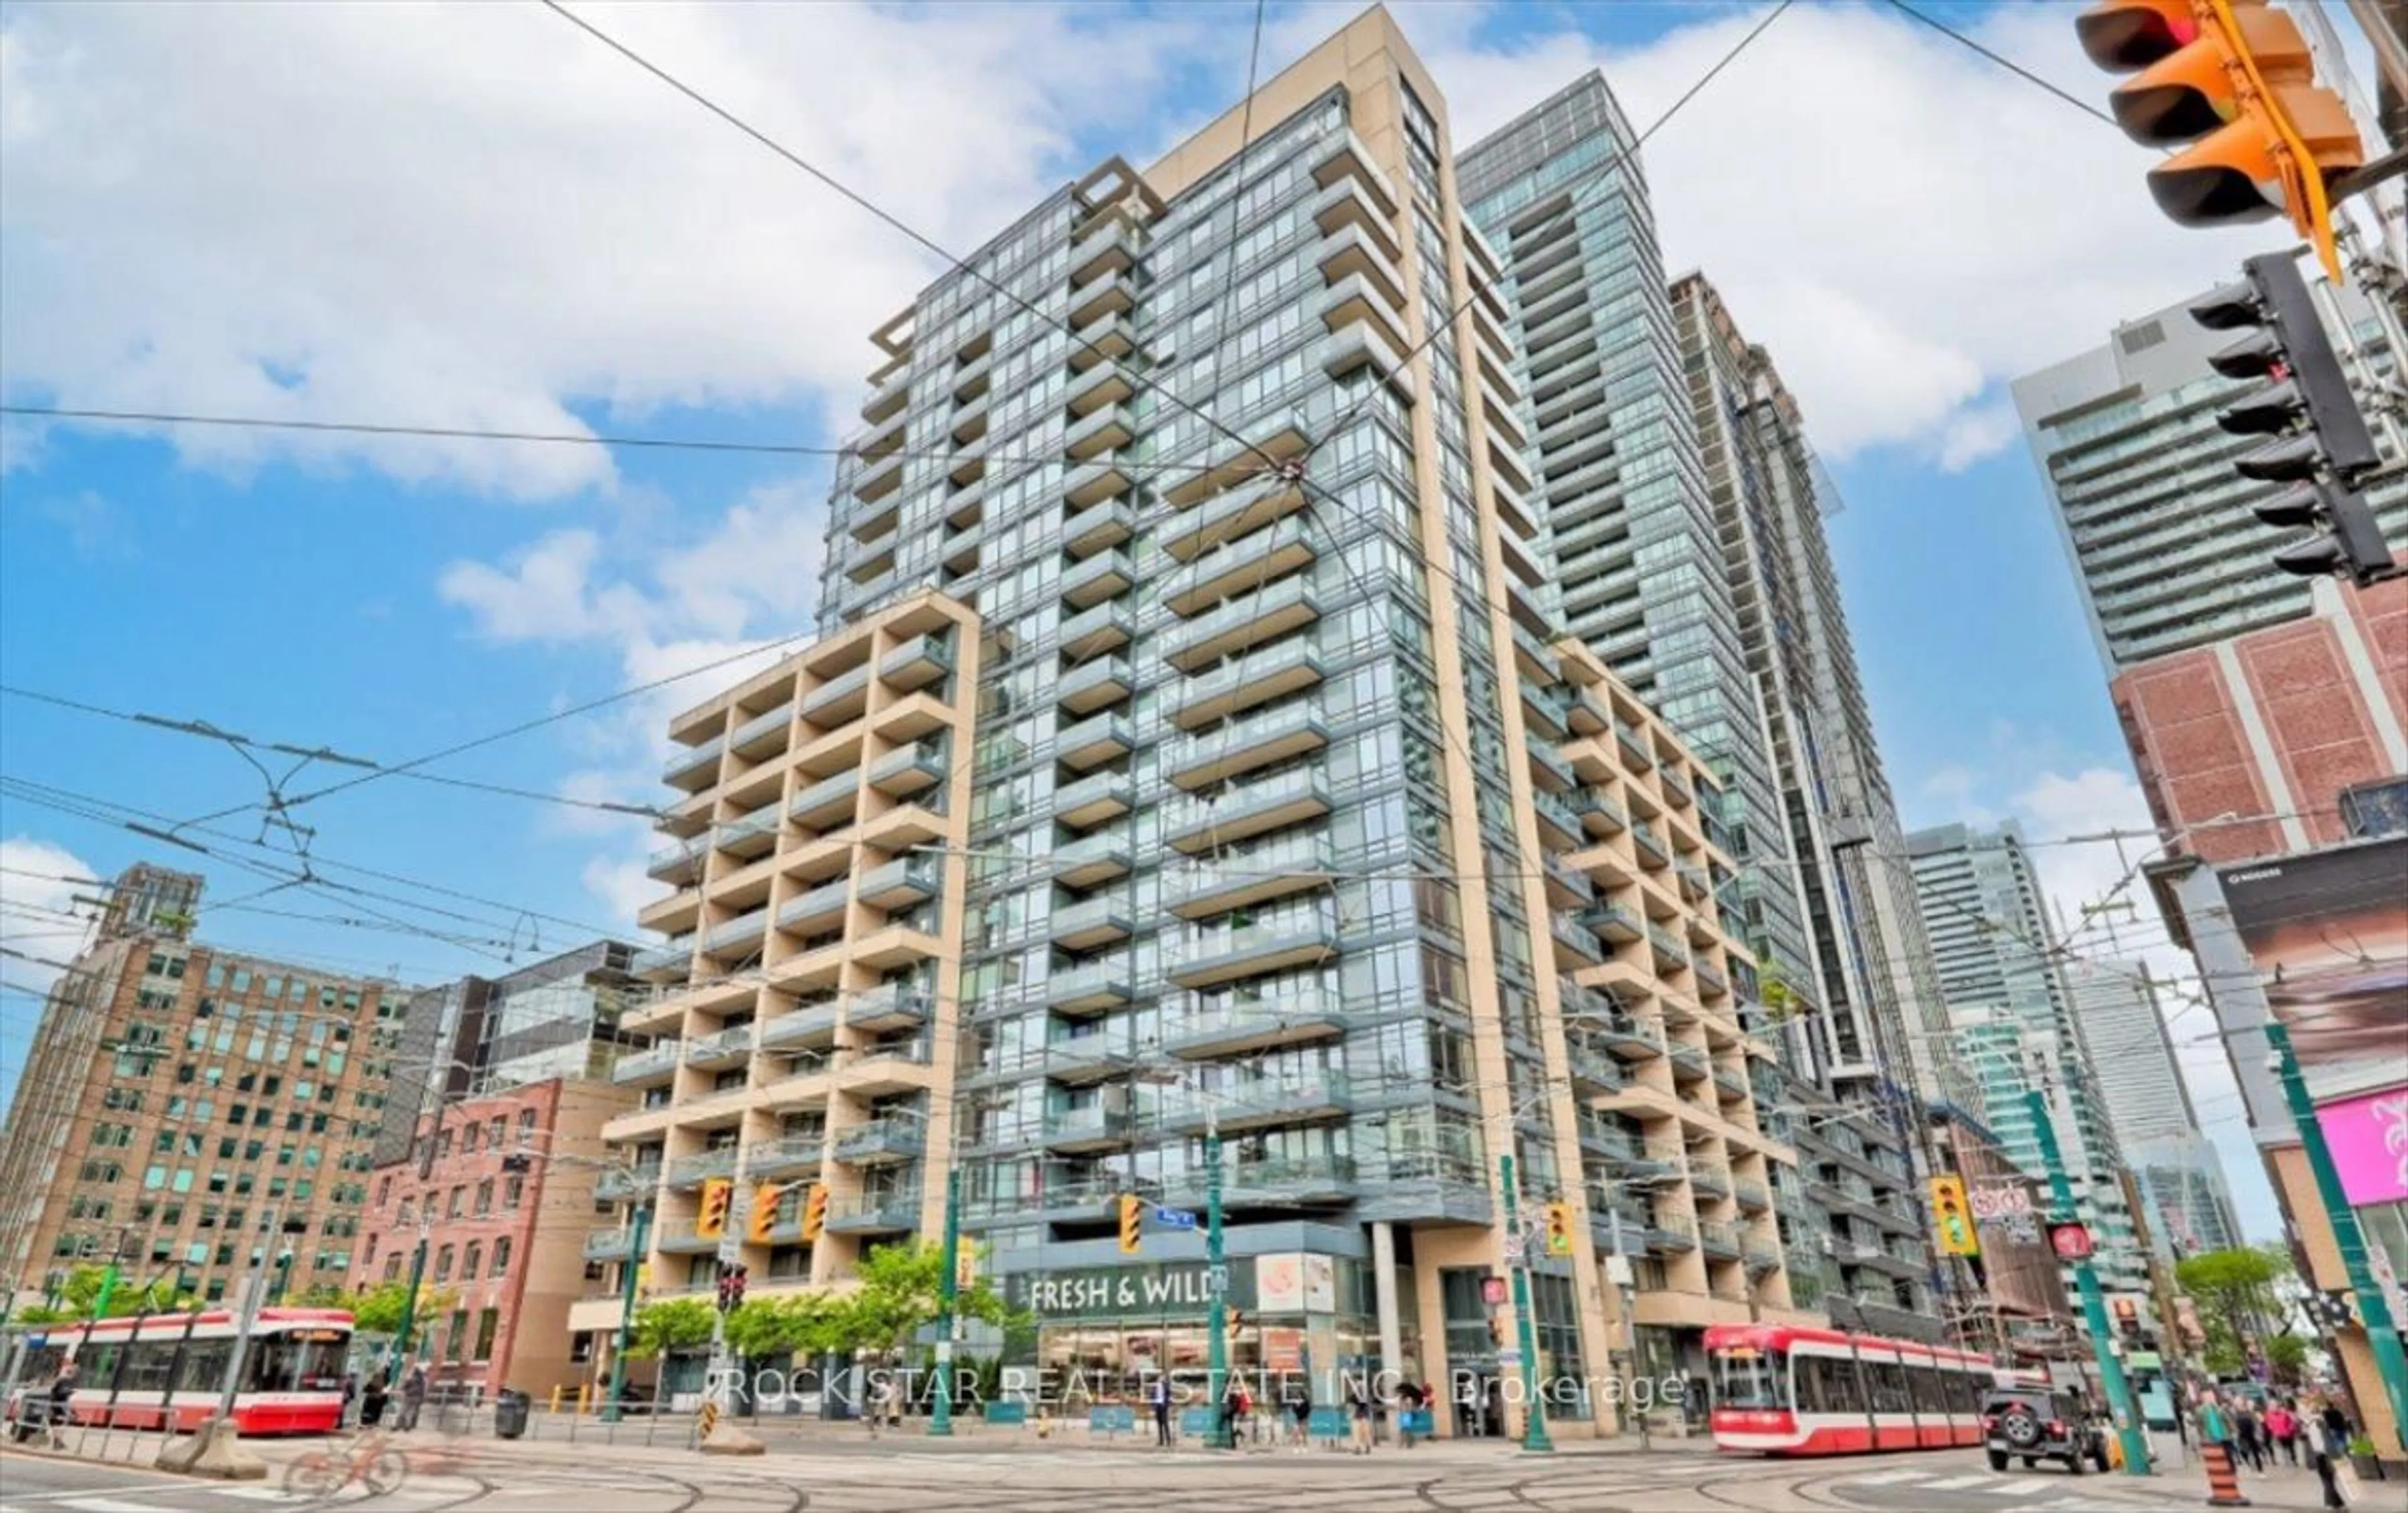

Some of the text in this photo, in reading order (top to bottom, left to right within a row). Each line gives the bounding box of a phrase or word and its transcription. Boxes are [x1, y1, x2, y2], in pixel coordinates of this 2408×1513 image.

[1032, 1272, 1212, 1309] FRESH & WILD
